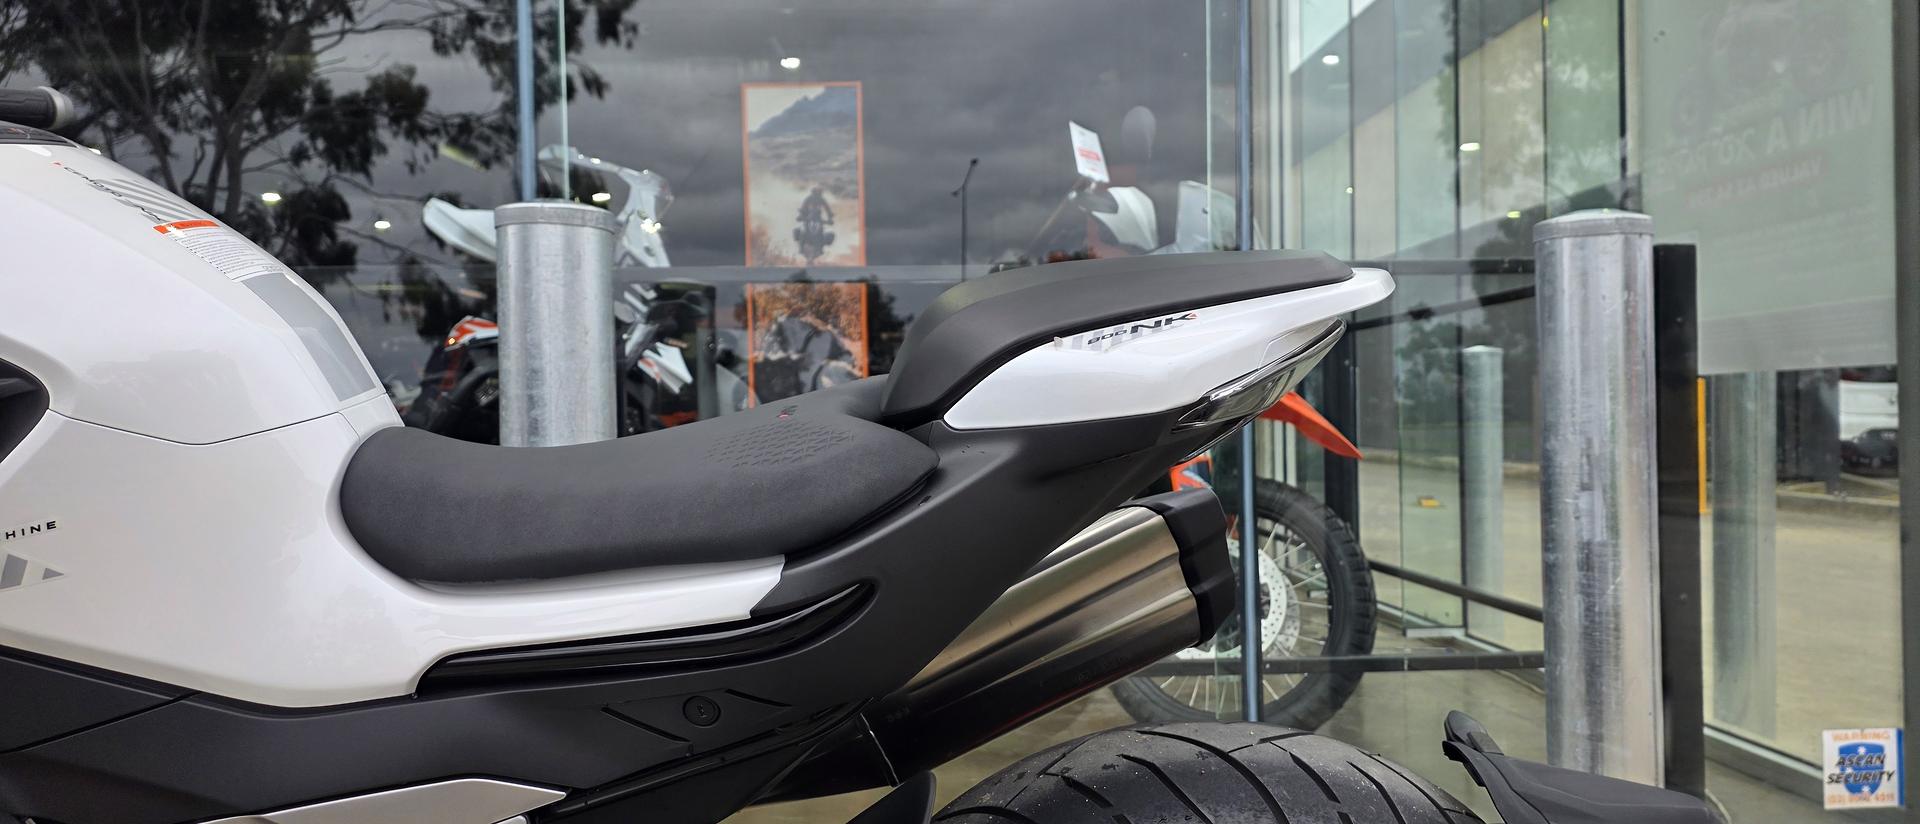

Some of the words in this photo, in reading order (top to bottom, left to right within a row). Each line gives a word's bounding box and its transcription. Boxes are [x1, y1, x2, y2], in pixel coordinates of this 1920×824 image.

[5, 520, 57, 540] HINE
[1835, 752, 1886, 768] ASCAN
[1825, 770, 1896, 785] SECURITY
